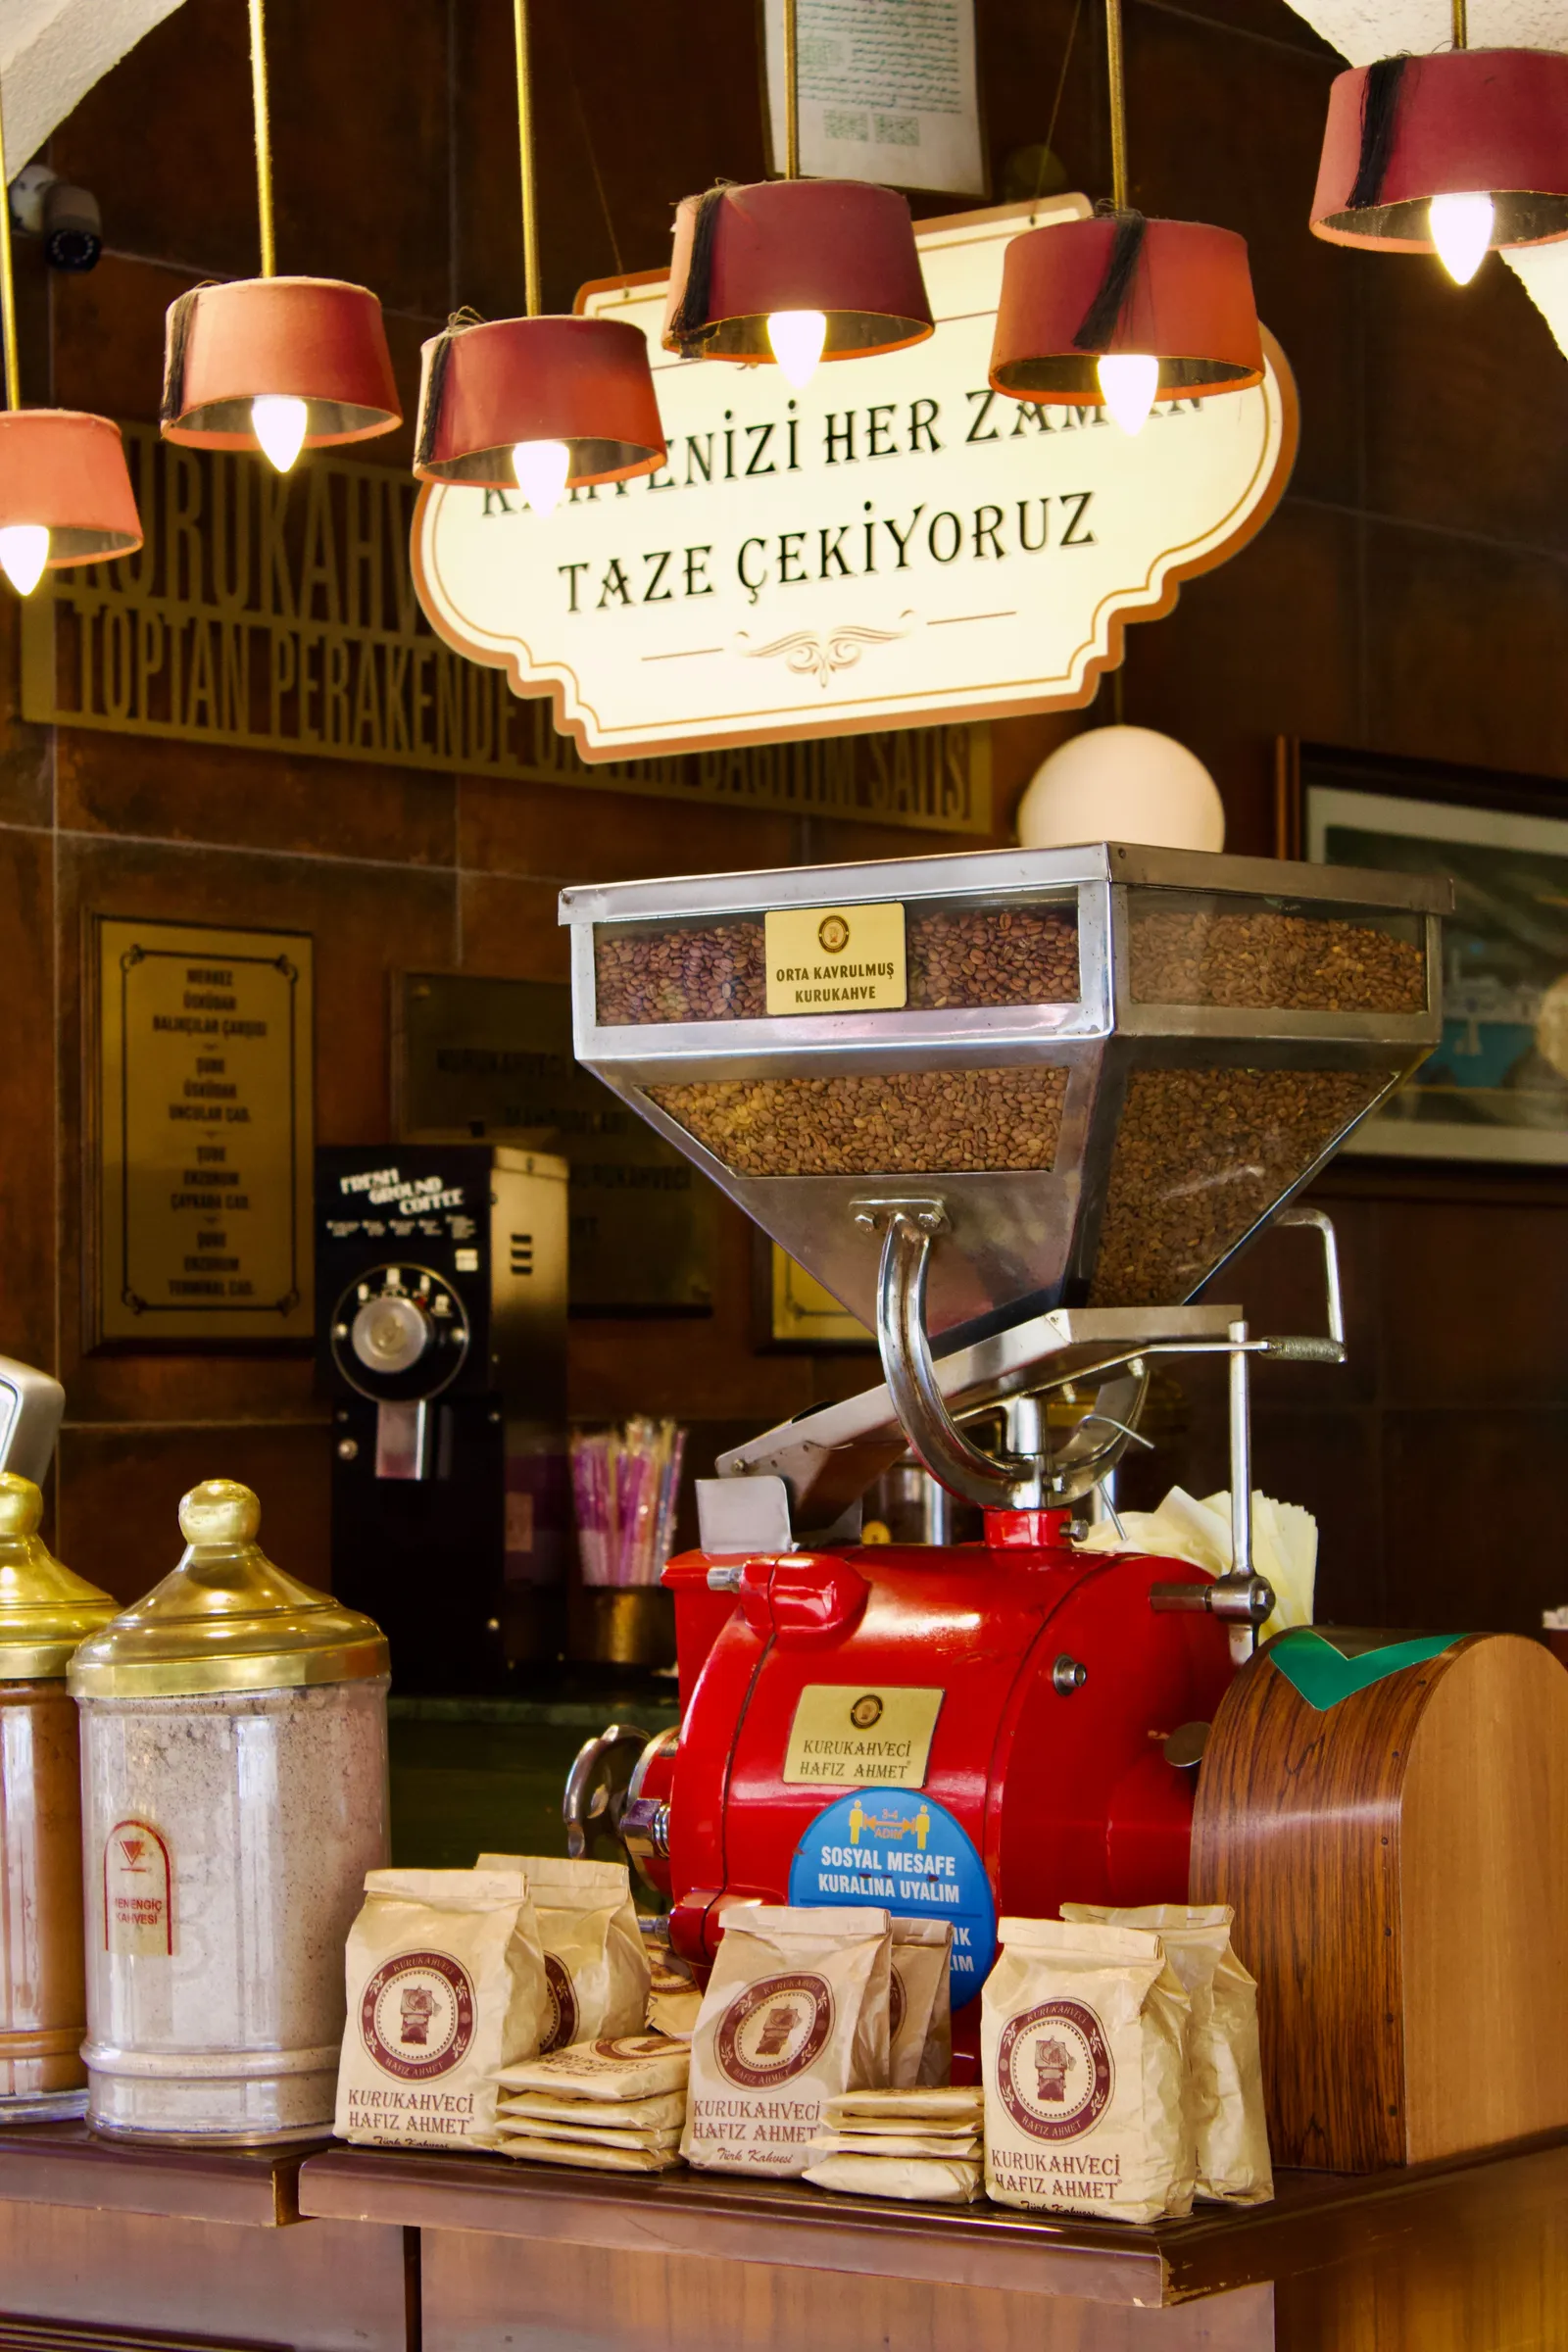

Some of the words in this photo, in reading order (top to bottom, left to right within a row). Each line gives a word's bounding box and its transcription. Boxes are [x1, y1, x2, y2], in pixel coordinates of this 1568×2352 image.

[483, 399, 800, 515] KENİZİ
[823, 398, 944, 465] HER
[965, 389, 1204, 444] ZAM
[558, 545, 714, 613] TAZE
[738, 491, 1098, 605] ÇEKİYORUZ
[75, 602, 250, 734] TOPTAN
[273, 626, 519, 765] PERAKENDE
[776, 967, 809, 981] ORTA
[813, 962, 895, 979] KAVRULMUŞ
[795, 986, 876, 1003] KURUKAHVE
[803, 1740, 912, 1758] KURUKAHVECİ
[800, 1761, 846, 1777] HAFIZ
[874, 1827, 904, 1840] ADIM
[821, 1845, 883, 1871] SOSYAL
[887, 1851, 956, 1877] MESAFE
[818, 1873, 896, 1898] KURALINA
[900, 1880, 960, 1903] UYALIM
[348, 2089, 474, 2114] KURUKAHVECİ
[693, 2099, 822, 2122] KURUKAHVECİ
[349, 2111, 400, 2131] HAFIZ
[693, 2122, 747, 2140] HAFIZ
[717, 2147, 743, 2162] Türk
[748, 2149, 794, 2164] Kahvesi
[992, 2149, 1121, 2178] KURUKAHVECİ
[995, 2173, 1047, 2195] HAFIZ
